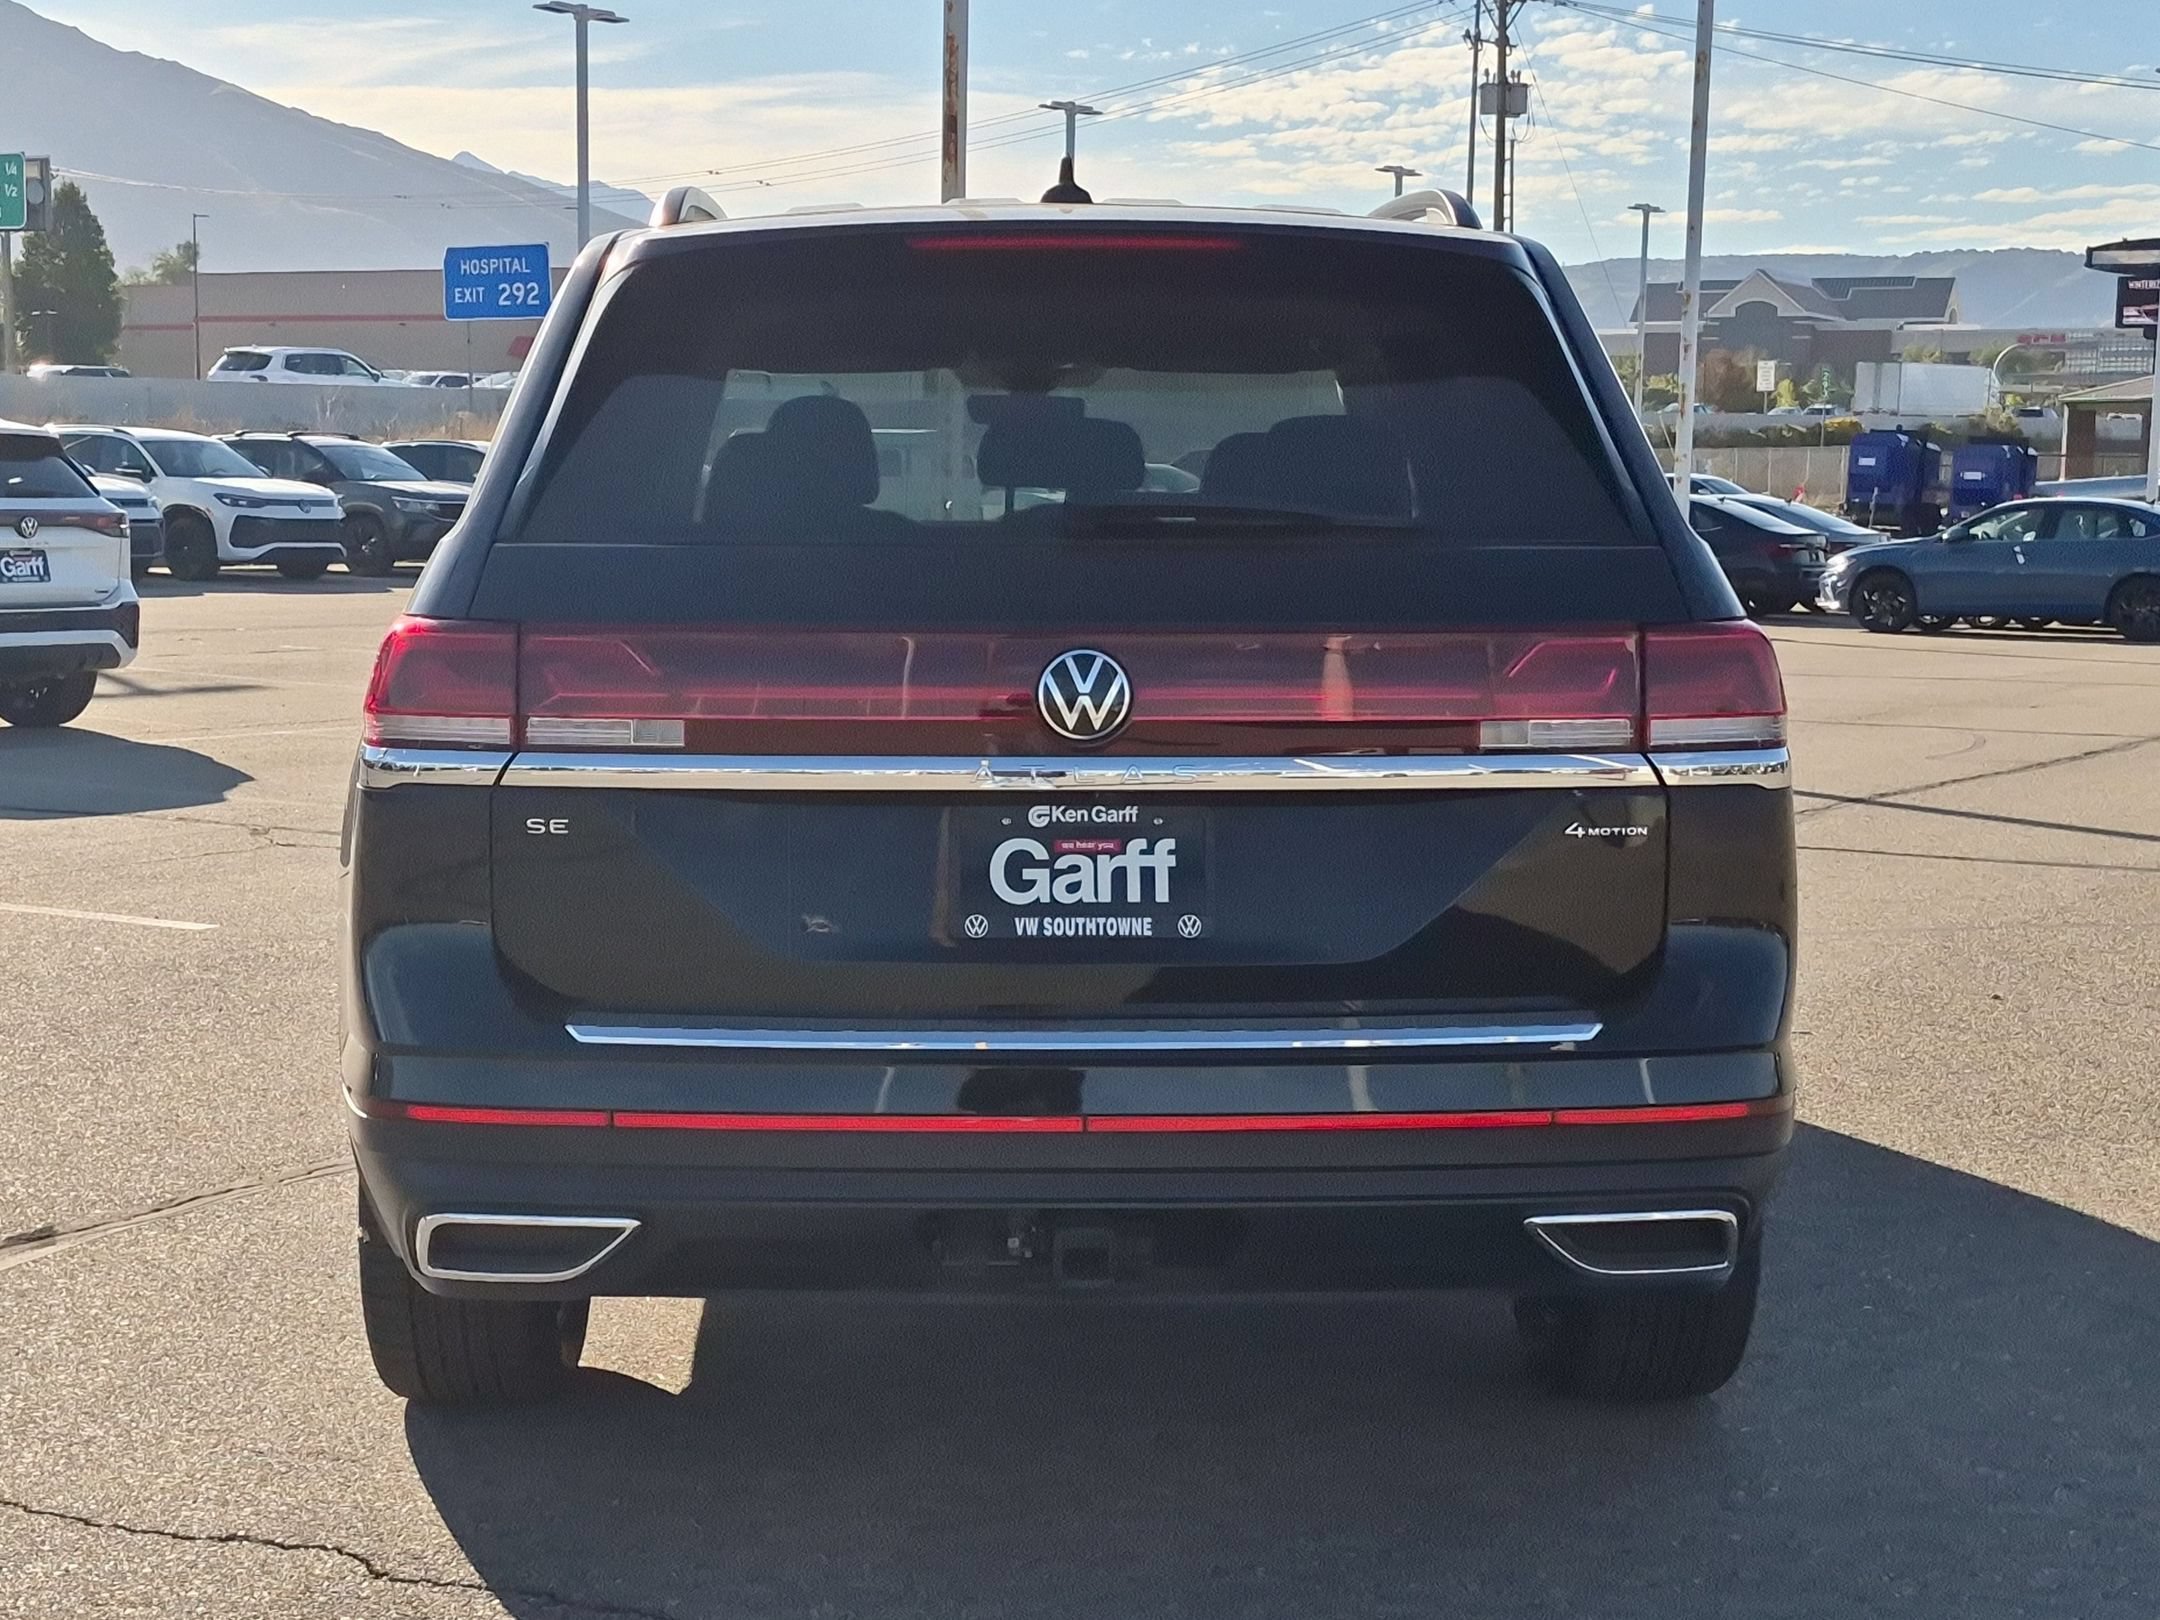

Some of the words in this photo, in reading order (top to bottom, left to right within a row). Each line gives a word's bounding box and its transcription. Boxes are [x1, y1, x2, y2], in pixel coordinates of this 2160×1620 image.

[460, 257, 531, 275] HOSPITAL
[454, 287, 485, 303] EXIT
[498, 282, 540, 306] 292
[0, 556, 44, 577] Garff
[1040, 652, 1130, 736] VW
[971, 763, 1198, 784] ATLAS
[1052, 805, 1088, 822] Ken
[1091, 805, 1138, 823] Garff
[526, 818, 569, 834] SE
[1564, 822, 1648, 838] 4MOTION
[989, 837, 1177, 905] Garff
[1014, 917, 1039, 936] VW
[1043, 917, 1152, 936] SOUTHTOWNE
